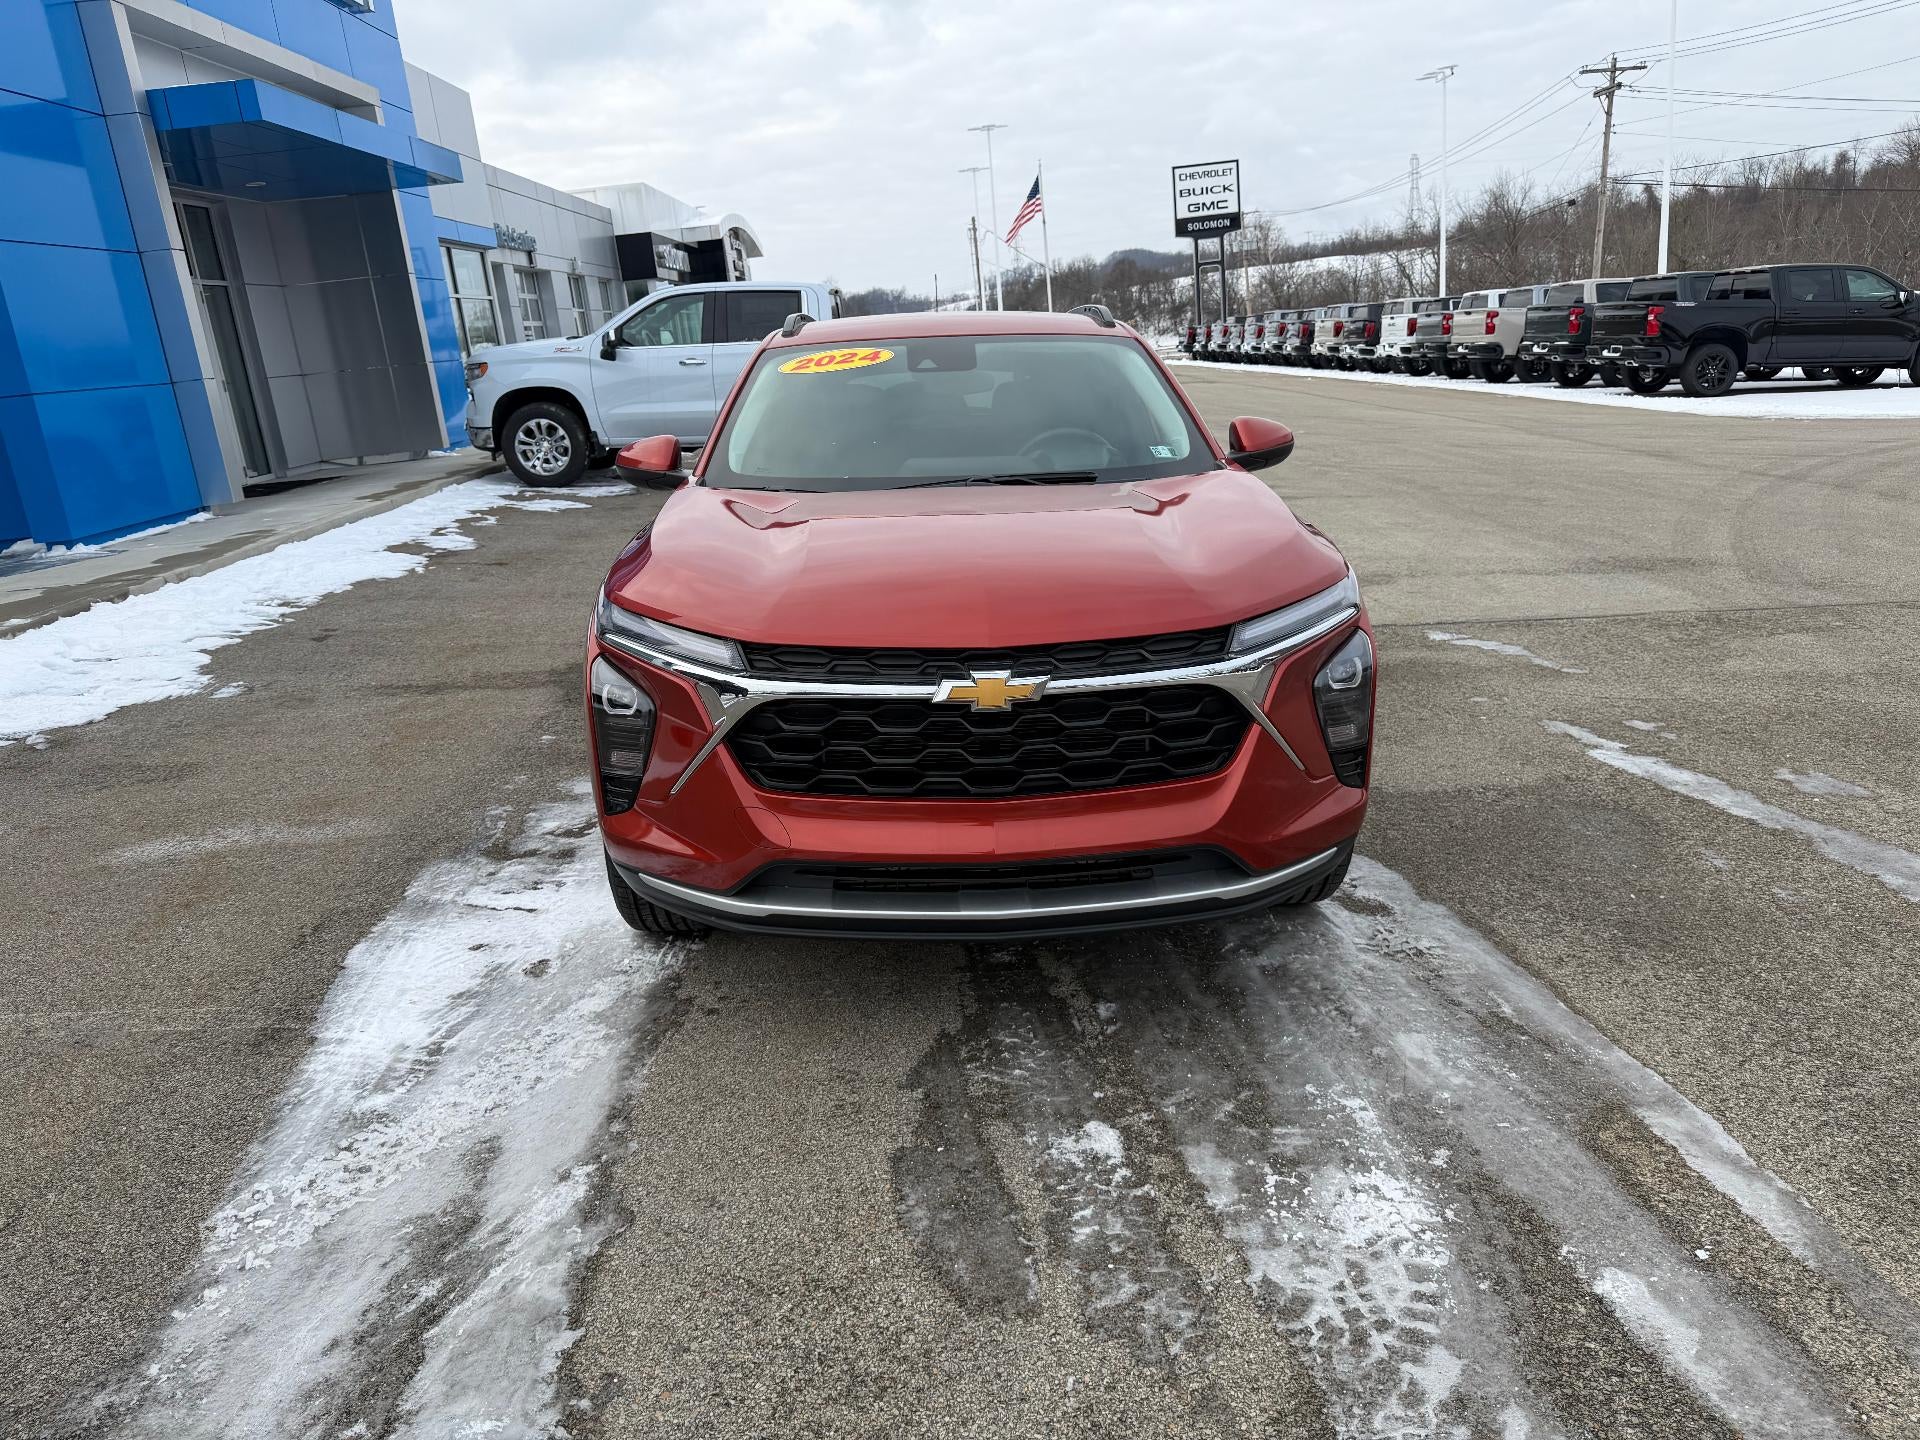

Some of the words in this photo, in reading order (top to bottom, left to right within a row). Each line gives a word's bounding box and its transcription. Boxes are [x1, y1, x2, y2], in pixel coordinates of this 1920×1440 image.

[1178, 168, 1233, 181] CHEVROLET
[1179, 184, 1234, 198] BUICK
[1187, 200, 1228, 213] GMC
[1187, 219, 1230, 231] SOLOMON
[789, 350, 882, 371] 2024
